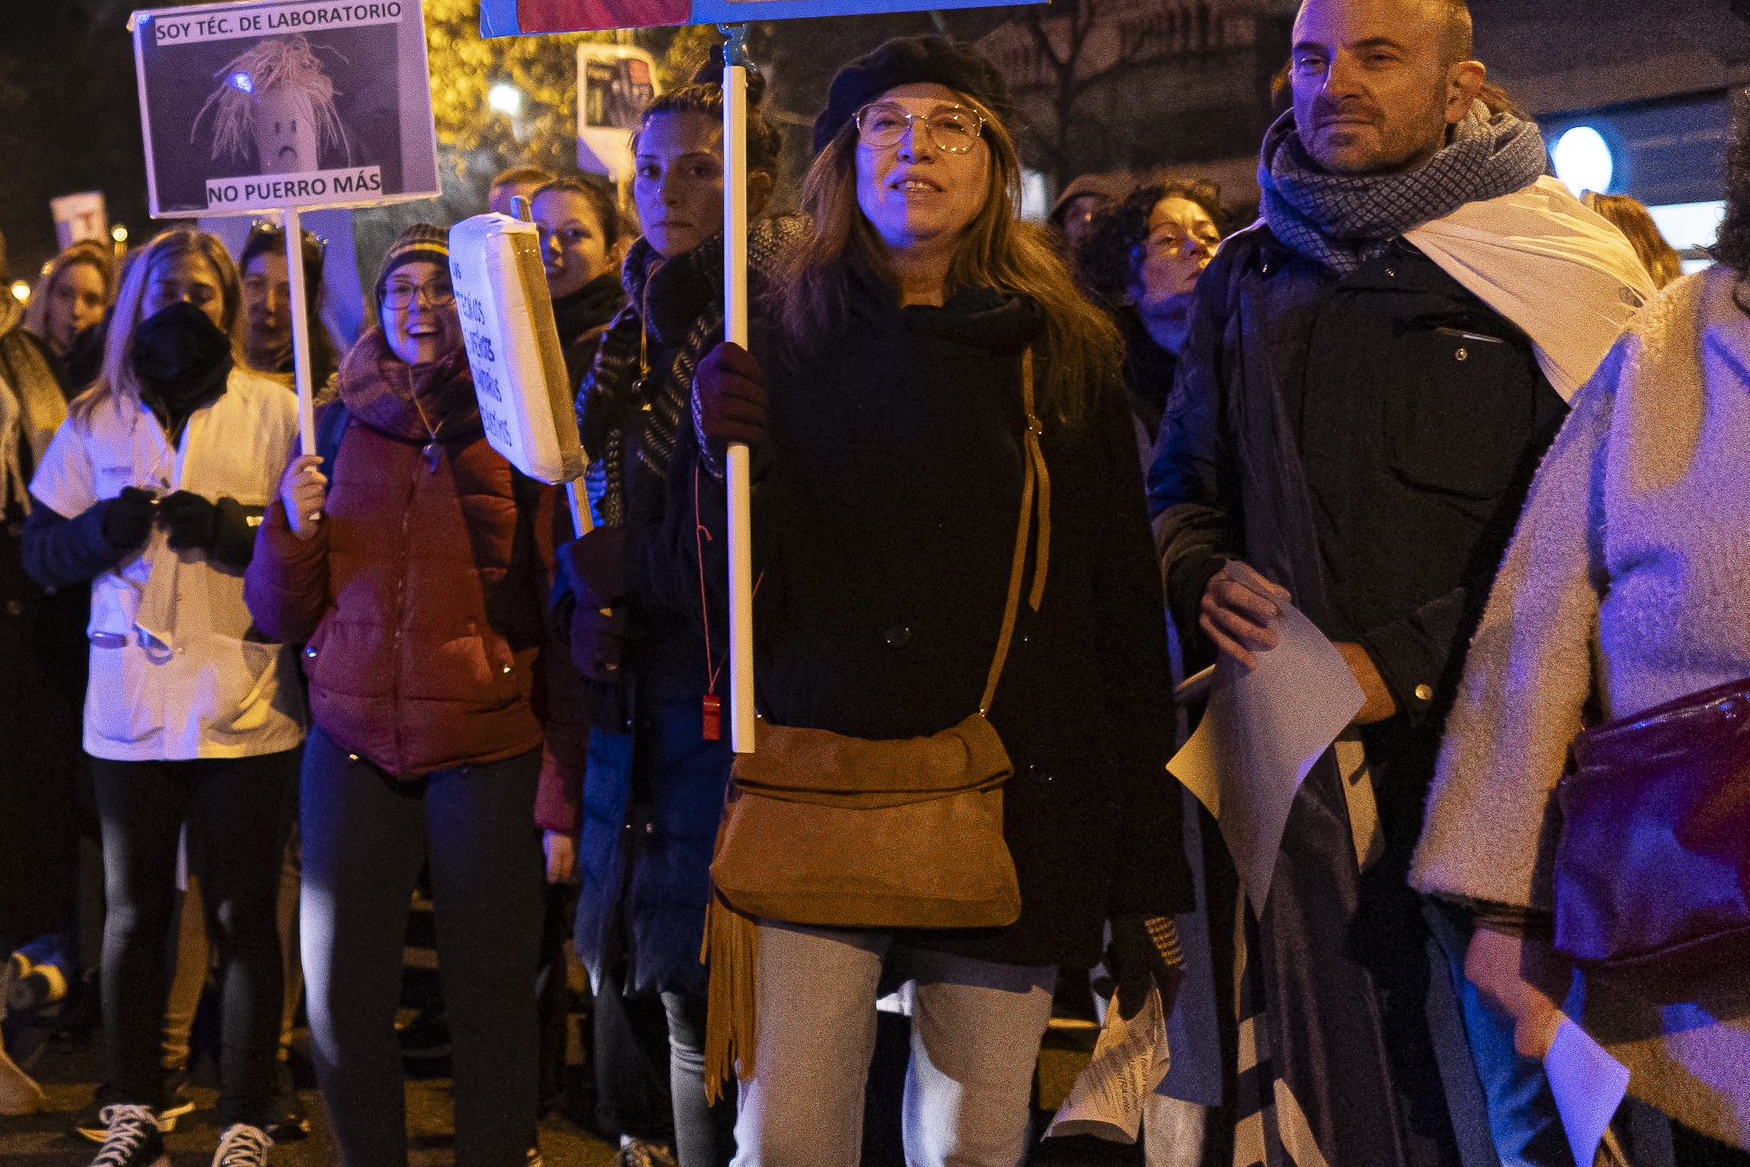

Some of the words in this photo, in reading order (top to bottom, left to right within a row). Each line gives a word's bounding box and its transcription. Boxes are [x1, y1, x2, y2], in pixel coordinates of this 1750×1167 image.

[156, 22, 191, 40] SOY
[197, 16, 233, 35] TÉC.
[239, 15, 262, 32] DE
[268, 2, 401, 29] LABORATORIO
[208, 185, 238, 203] NO
[245, 179, 327, 200] PUERRO
[333, 170, 381, 194] MÁS
